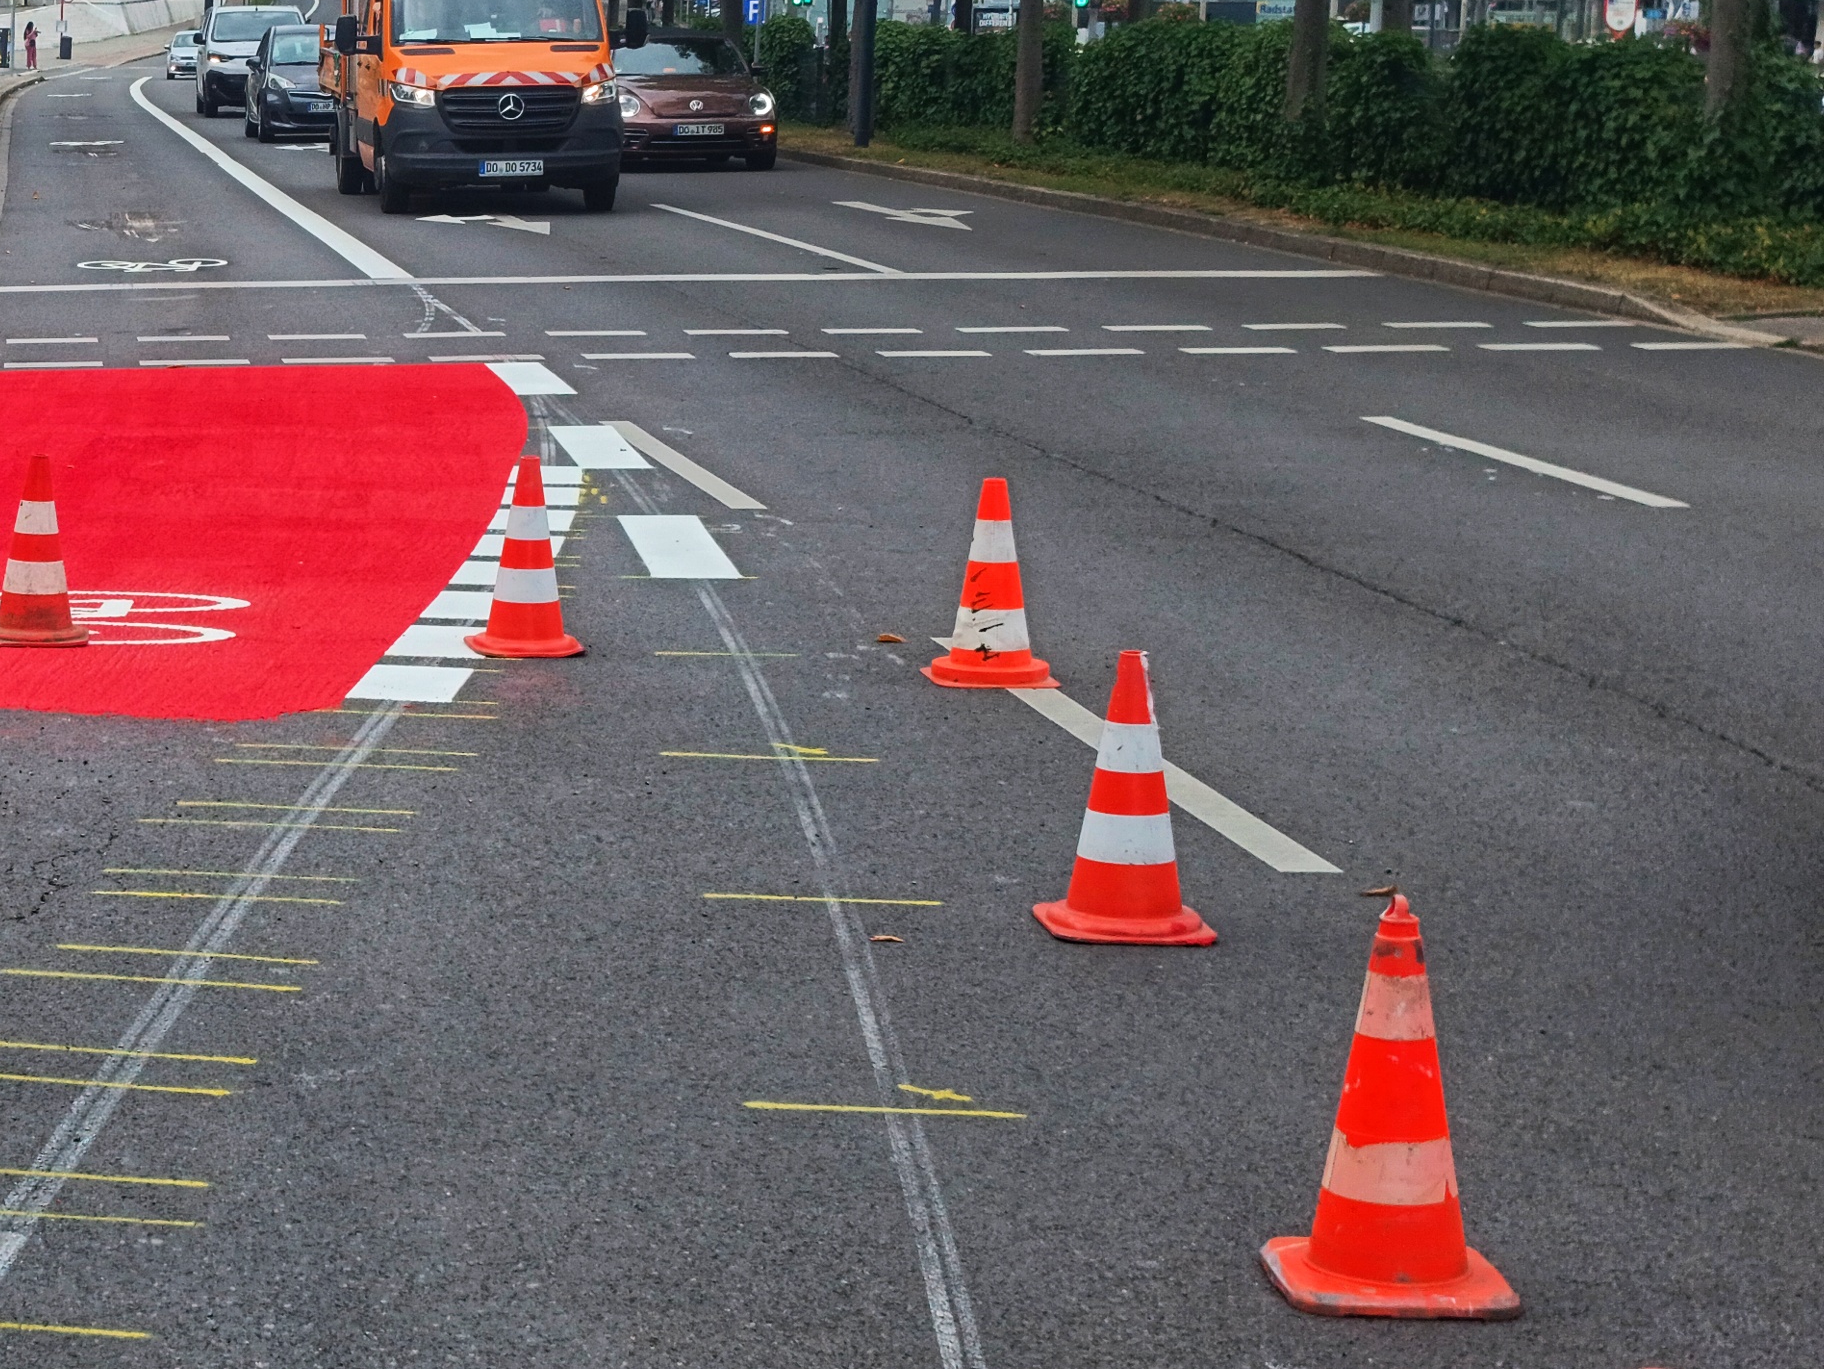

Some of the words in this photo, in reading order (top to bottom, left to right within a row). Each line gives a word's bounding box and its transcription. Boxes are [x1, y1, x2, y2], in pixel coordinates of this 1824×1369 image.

[678, 125, 690, 134] DO
[486, 162, 498, 173] DO
[505, 162, 517, 172] DO
[519, 161, 543, 172] 5734
